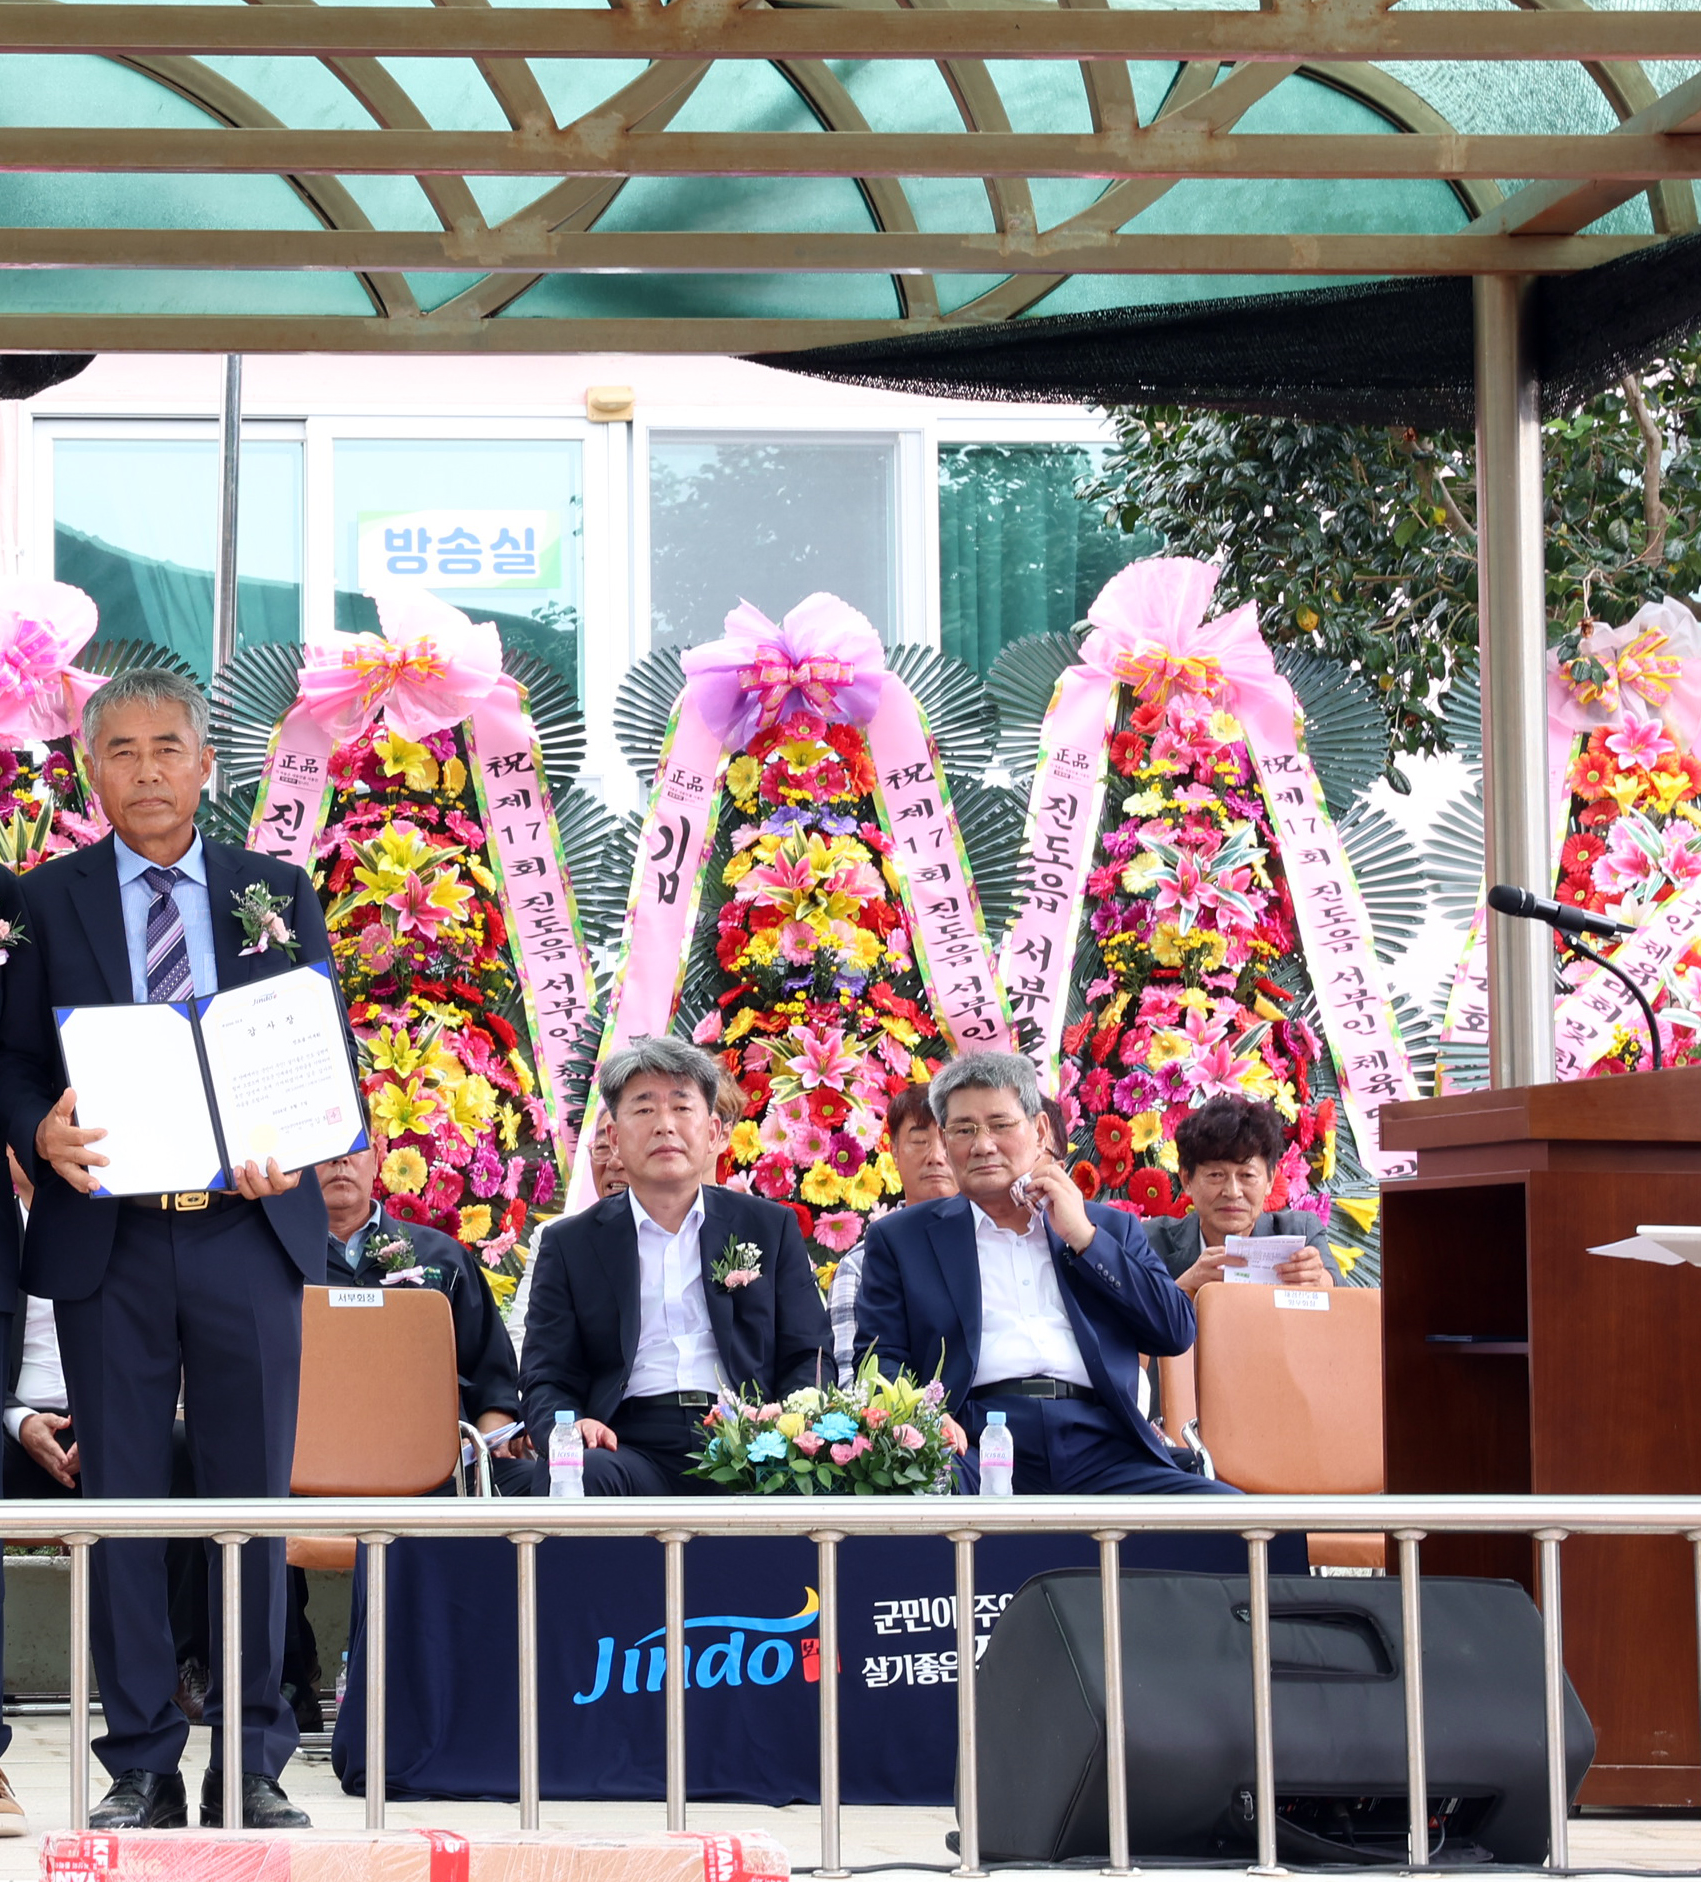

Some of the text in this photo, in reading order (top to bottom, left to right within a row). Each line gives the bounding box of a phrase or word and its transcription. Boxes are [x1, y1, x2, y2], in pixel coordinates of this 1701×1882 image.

[384, 527, 536, 574] 방송실
[279, 754, 319, 774] 正品
[486, 753, 535, 777] 祝
[669, 769, 704, 792] 正品
[1053, 748, 1090, 770] 正品
[1262, 755, 1303, 774] 祝
[493, 789, 546, 877] 제17회
[651, 815, 690, 904] 김
[1030, 793, 1078, 913] 진도읍
[1275, 787, 1331, 866] 제17회
[517, 892, 574, 962] 진도읍
[884, 763, 997, 1041] 祝 제17회 진도읍 서부인
[1307, 881, 1360, 953] 진도읍
[1329, 966, 1377, 1035] 서부인
[1582, 939, 1673, 1023] 체육대회
[338, 1293, 375, 1303] 서부회장
[873, 1592, 1014, 1634] 군민이 주
[573, 1631, 794, 1705] Jindo
[862, 1650, 958, 1688] 살기좋은
